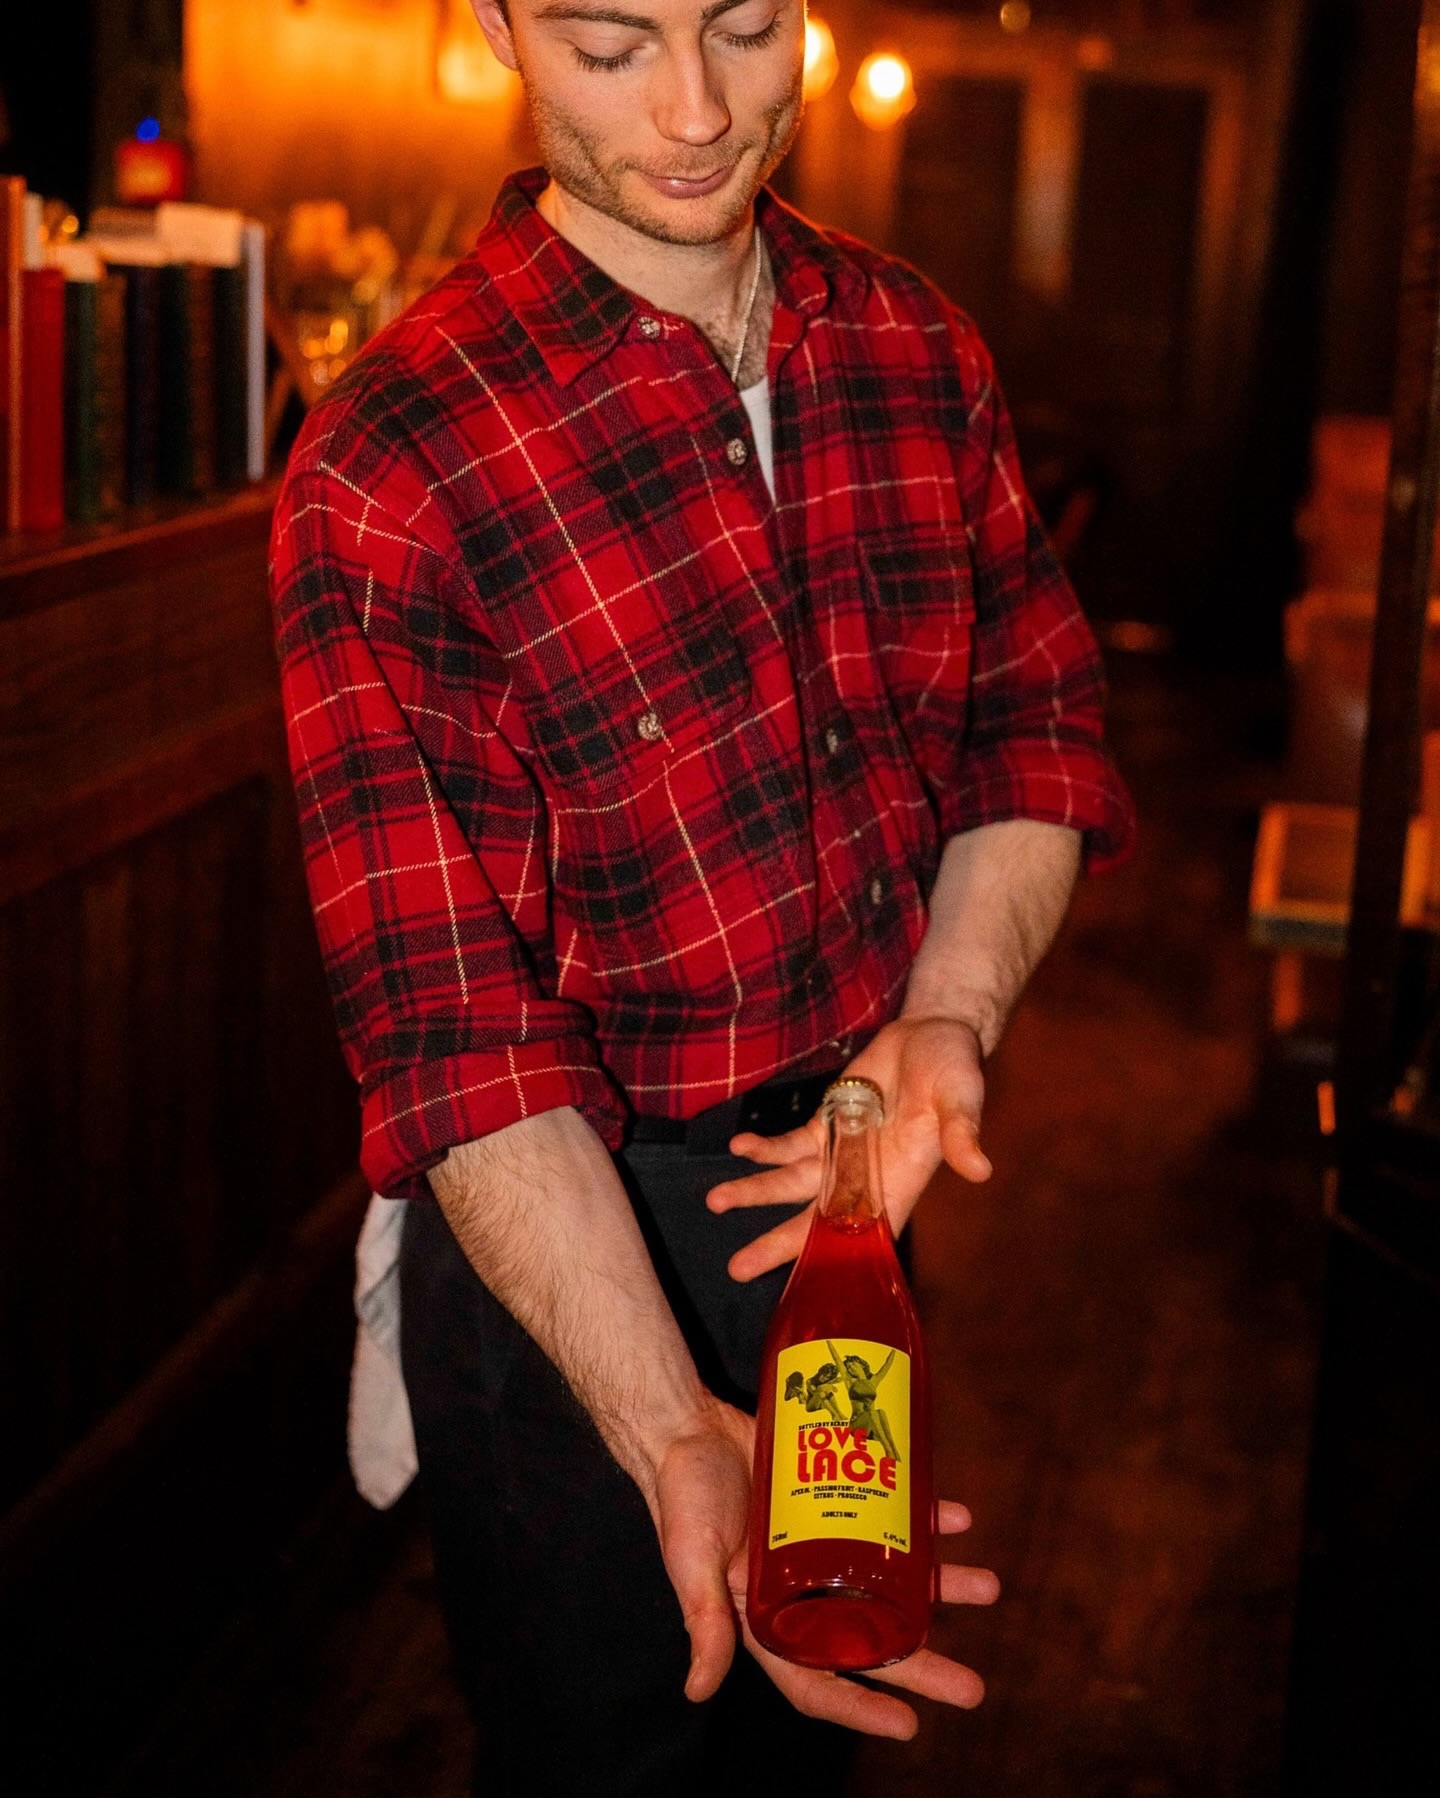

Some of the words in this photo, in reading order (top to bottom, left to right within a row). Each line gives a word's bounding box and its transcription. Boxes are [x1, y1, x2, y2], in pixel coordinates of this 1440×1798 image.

[798, 1421, 822, 1430] BOTTLED
[798, 1427, 868, 1451] LOVE
[798, 1449, 896, 1490] LACE
[838, 1492, 867, 1500] PROSECCO
[858, 1486, 889, 1498] RASPBERRY
